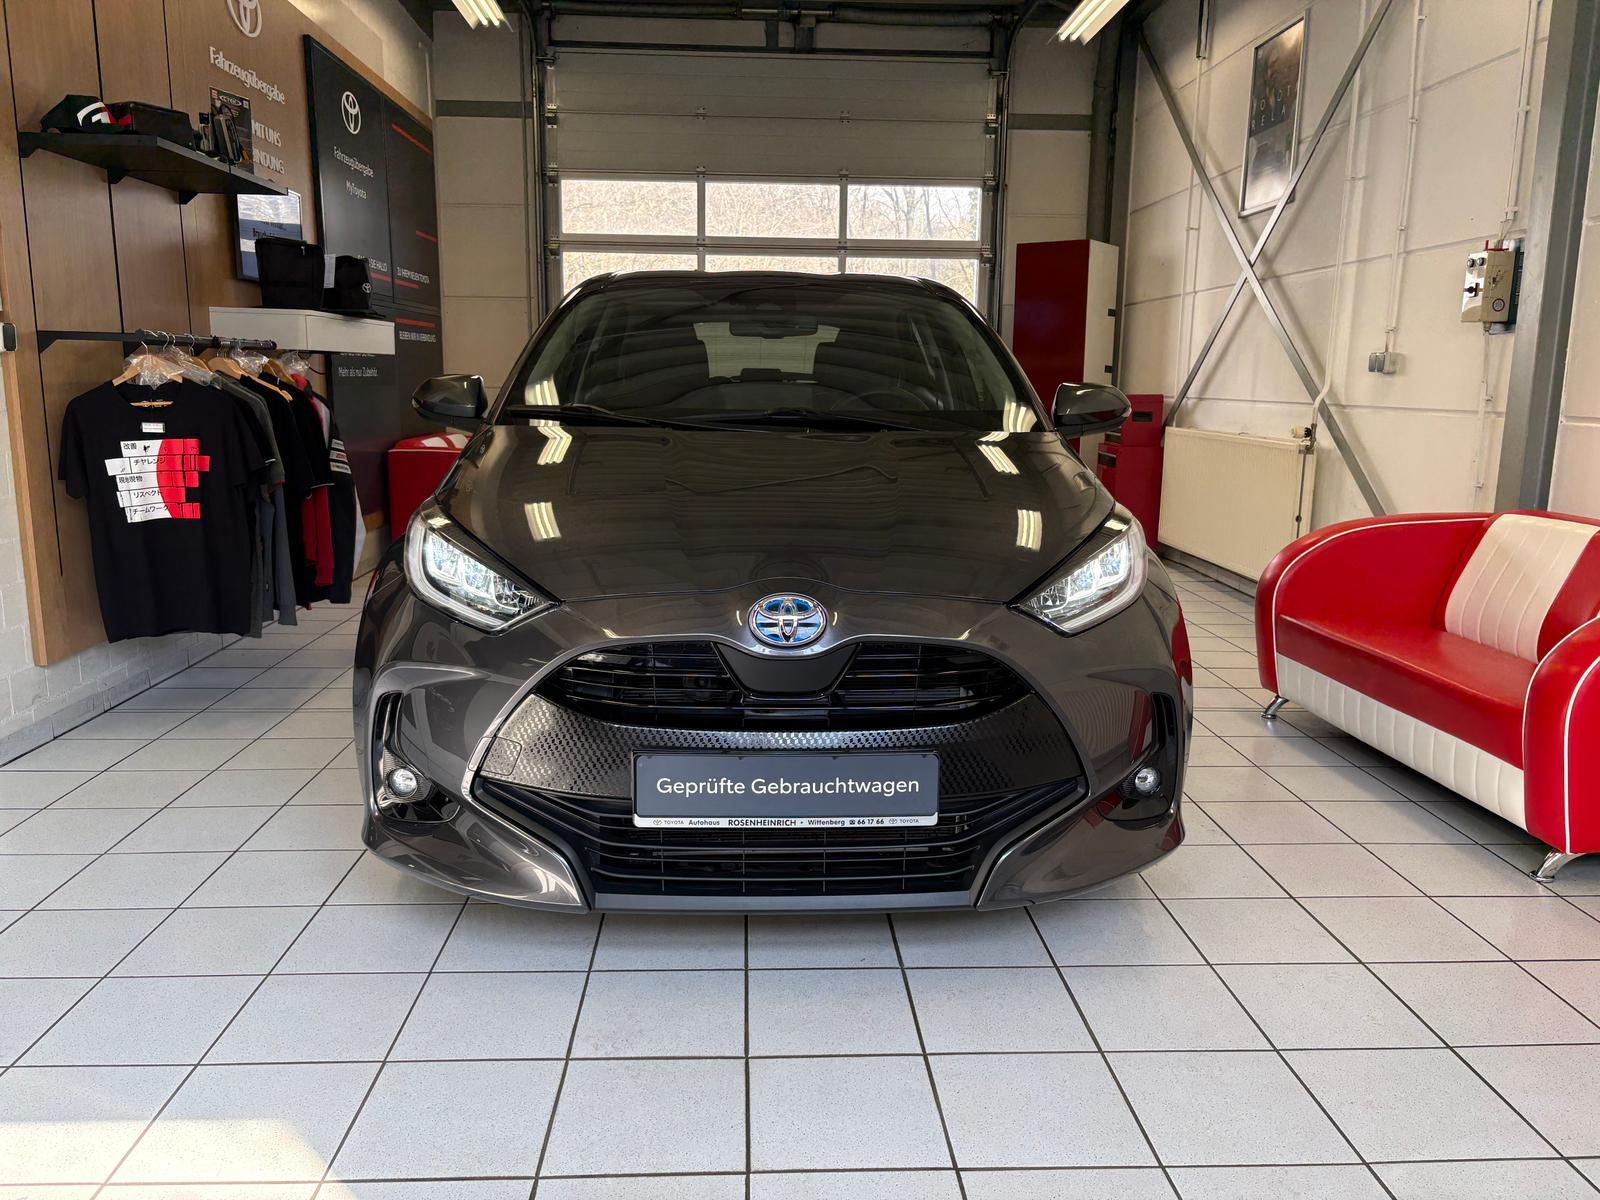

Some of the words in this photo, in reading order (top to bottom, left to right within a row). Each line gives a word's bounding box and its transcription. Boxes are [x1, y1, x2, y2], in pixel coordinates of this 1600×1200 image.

[209, 46, 285, 104] Fahrzeugübergabe
[265, 125, 282, 147] UNS
[334, 146, 374, 177] Fahrzeugübergabe
[346, 180, 367, 199] MyToyota
[338, 366, 349, 377] Mehr
[133, 456, 166, 466] チャレンジ
[133, 504, 169, 515] チームワーク
[656, 777, 746, 798] Geprüfte
[751, 777, 920, 797] Gebrauchtwagen
[727, 819, 797, 827] ROSENHEINRICH
[807, 819, 846, 827] Wittenberg
